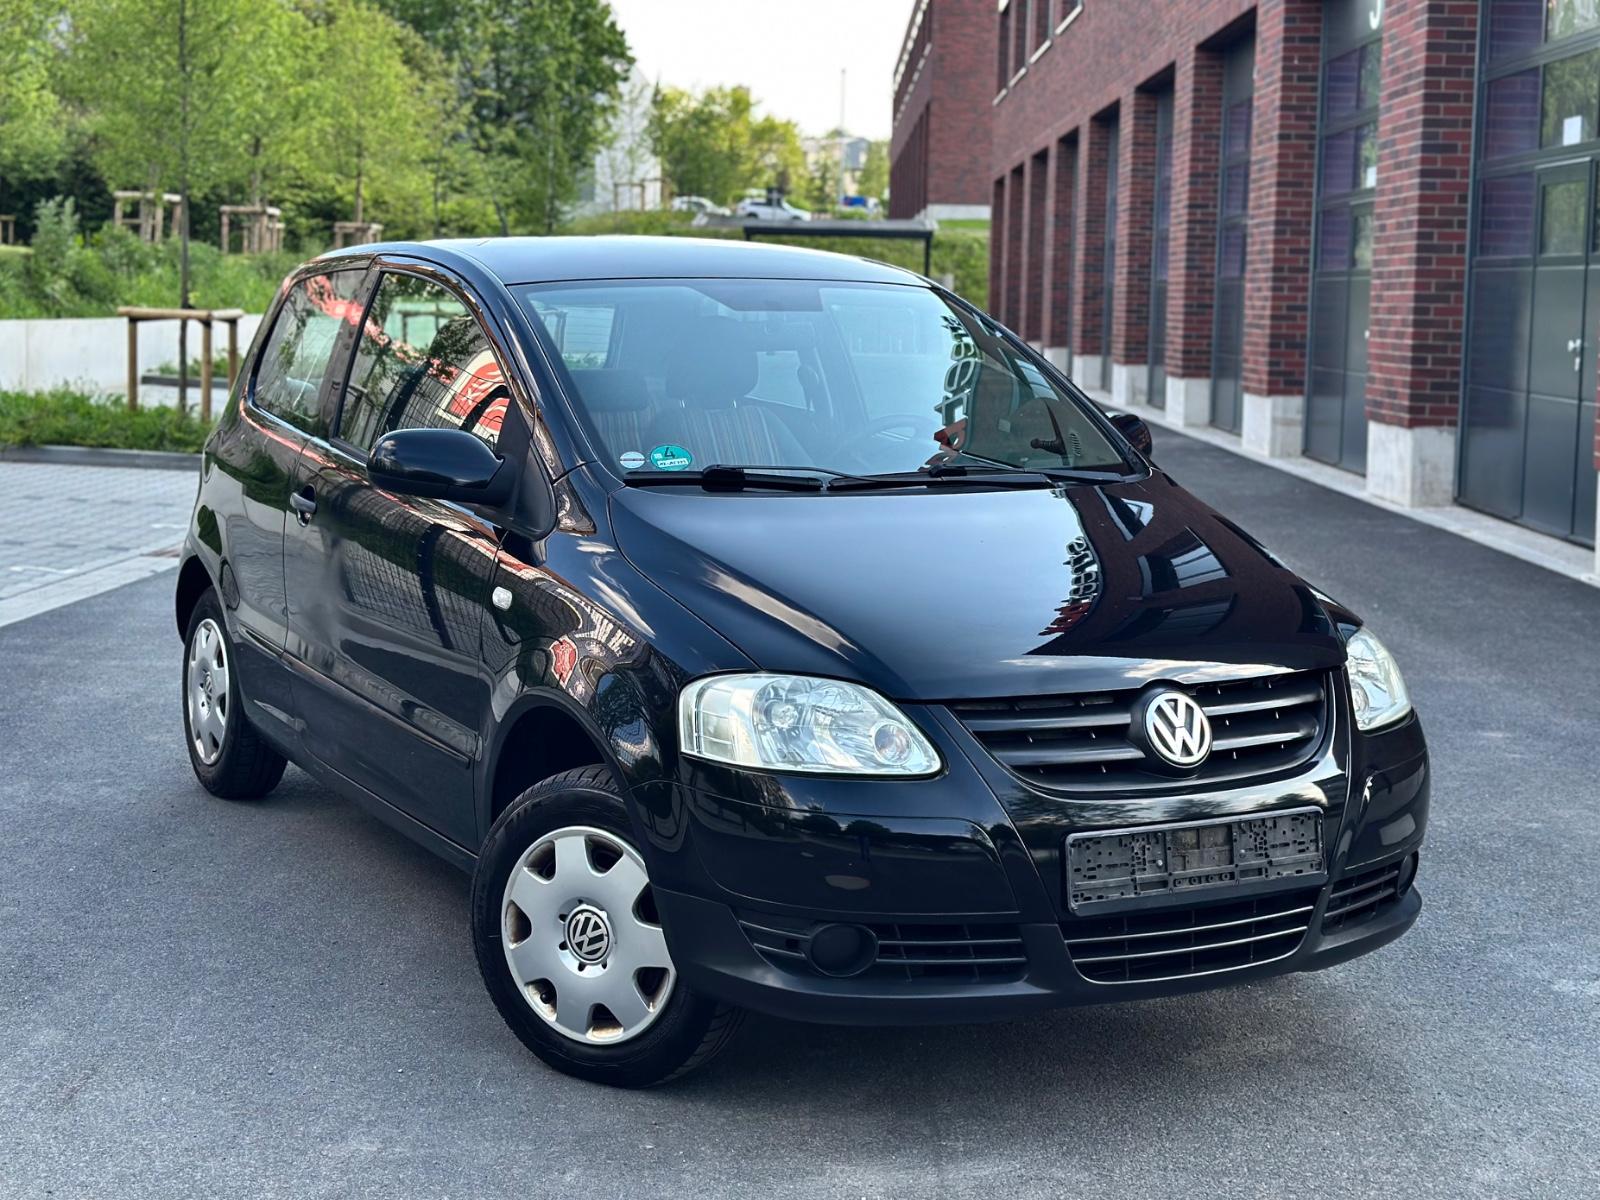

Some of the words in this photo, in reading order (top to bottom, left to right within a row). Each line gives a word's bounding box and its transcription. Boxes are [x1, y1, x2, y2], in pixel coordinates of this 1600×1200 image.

[664, 447, 676, 459] 4
[1145, 692, 1212, 764] VW
[569, 911, 609, 960] VW
